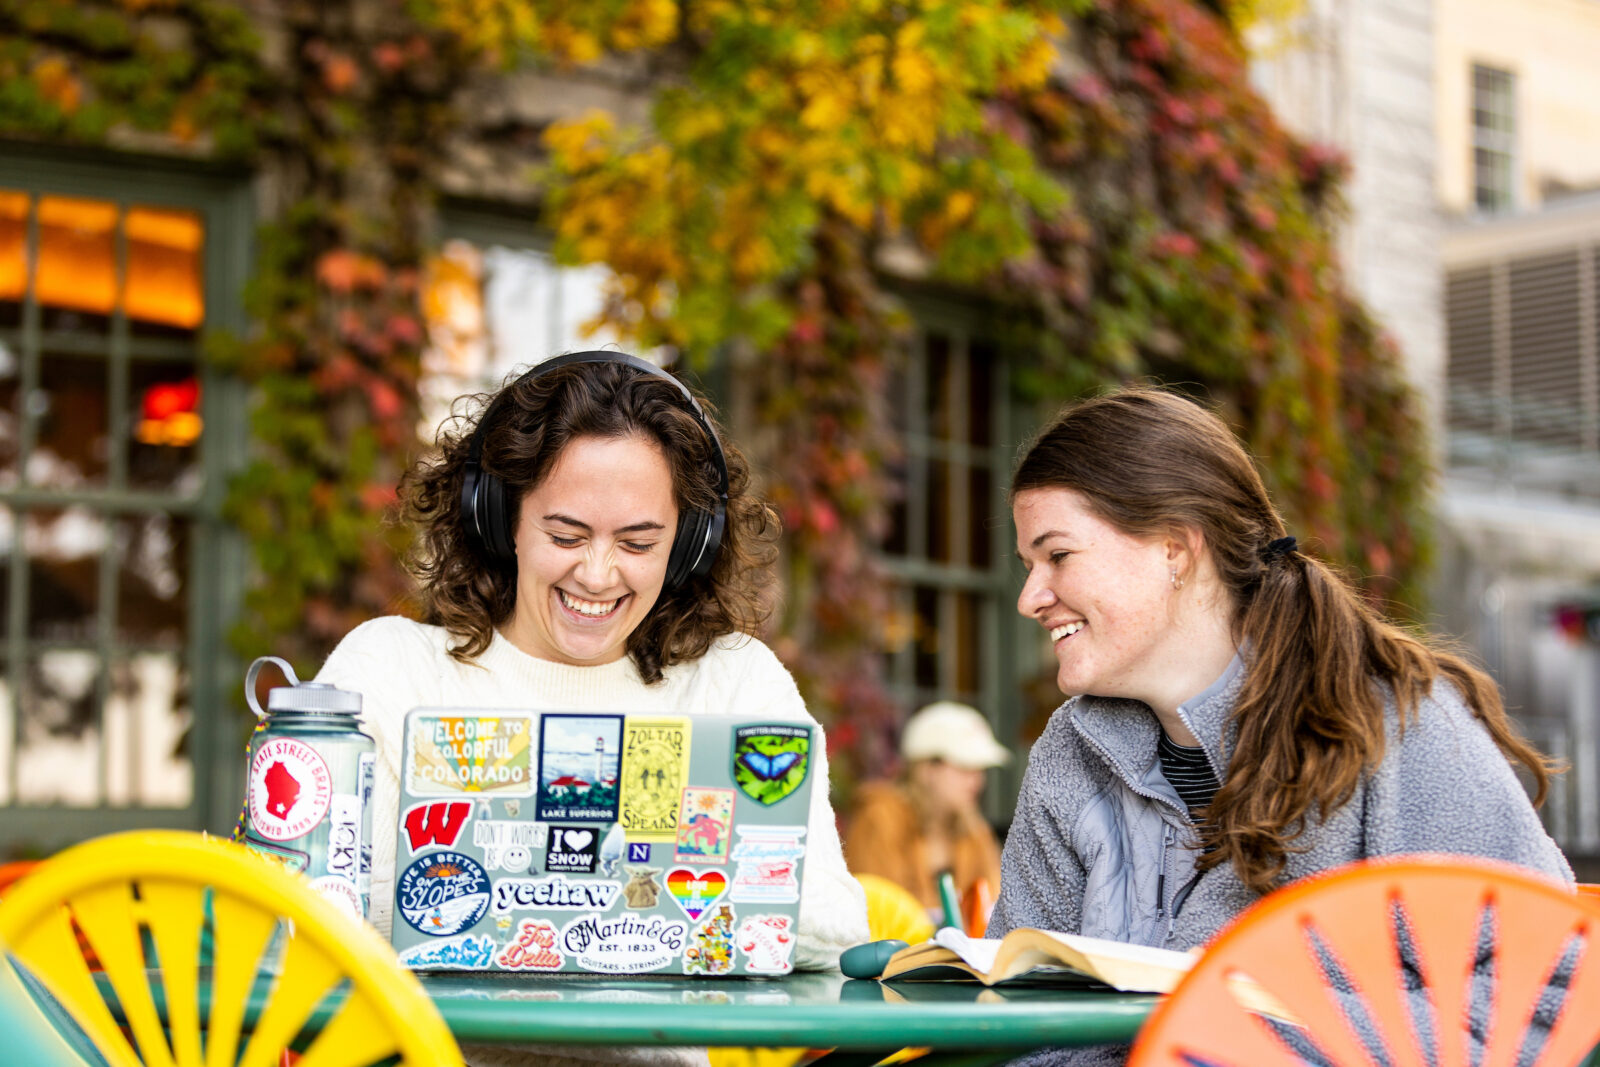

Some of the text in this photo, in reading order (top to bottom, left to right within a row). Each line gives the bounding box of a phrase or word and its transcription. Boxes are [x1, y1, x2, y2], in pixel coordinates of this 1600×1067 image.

[421, 719, 523, 742] WELCOME TO
[627, 730, 683, 750] ZOLTAR
[431, 737, 514, 760] COLORFUL
[252, 745, 273, 775] STATE
[276, 743, 317, 766] STREET
[312, 766, 328, 807] BRATS
[421, 765, 524, 782] COLORADO
[542, 809, 614, 819] LAKE SUPERIOR
[622, 809, 678, 829] SPEAKS
[553, 830, 563, 852] I
[548, 853, 593, 866] SNOW
[631, 845, 648, 860] N
[401, 853, 485, 893] LIFE IS BETTER
[416, 873, 474, 887] ON THE
[402, 880, 480, 910] SLOPES
[497, 878, 618, 910] yeehaw
[686, 880, 708, 891] LOVE
[684, 899, 707, 910] LOVE
[500, 944, 562, 968] Delta
[599, 944, 656, 953] EST. 1833
[581, 956, 668, 970] GUITARS STRINGS
